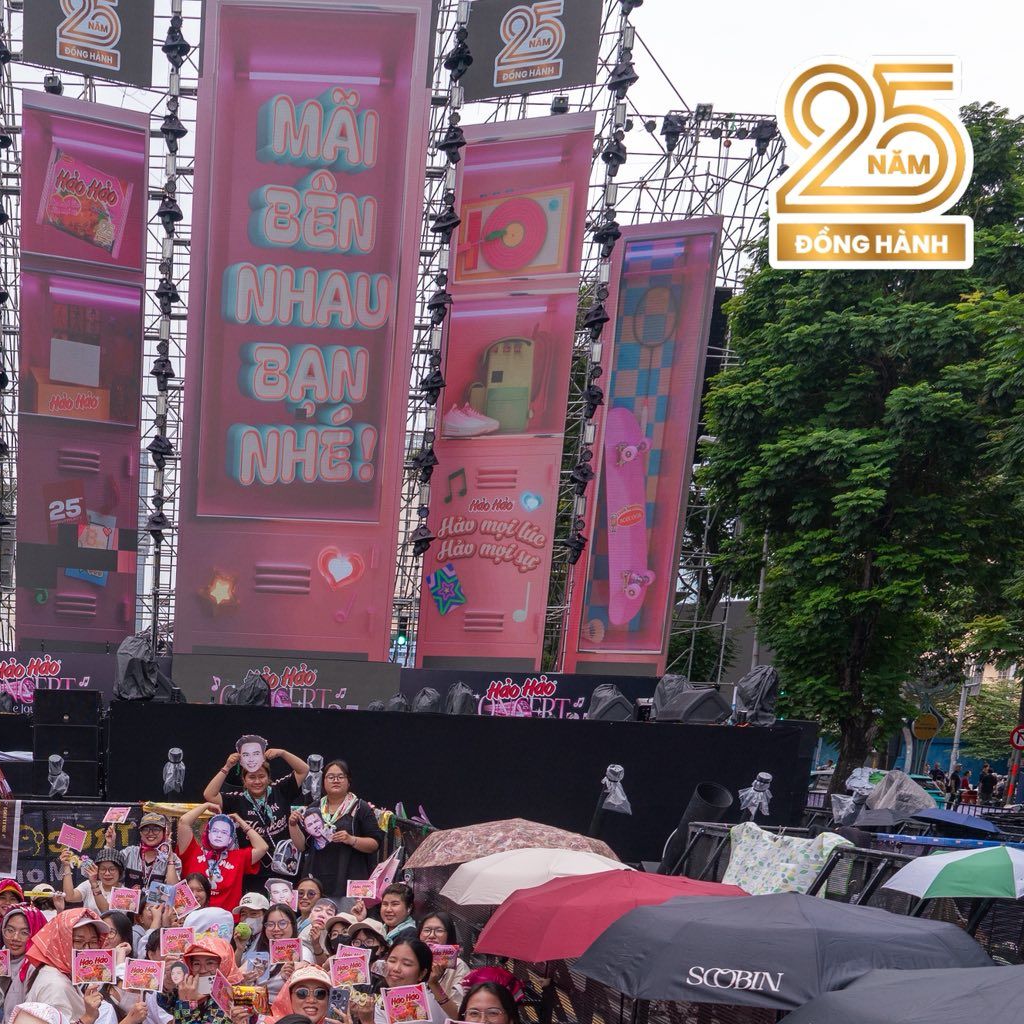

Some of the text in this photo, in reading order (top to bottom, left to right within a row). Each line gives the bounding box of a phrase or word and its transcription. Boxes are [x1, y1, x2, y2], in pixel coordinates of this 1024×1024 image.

[88, 21, 108, 33] NĂM
[497, 1, 564, 67] 25
[89, 50, 113, 64] HÀNH
[268, 87, 380, 170] MÃI
[56, 168, 118, 206] Hảo Hảo
[263, 170, 378, 252] BÊN
[233, 264, 392, 329] NHAU
[252, 345, 370, 419] BẠN
[238, 404, 378, 485] NHÉ!
[48, 497, 82, 521] 25
[437, 516, 546, 548] Hảo mọi lúc
[437, 540, 541, 573] Hảo mọi sự
[26, 654, 60, 678] Hảo
[280, 663, 317, 687] Hảo
[486, 675, 556, 700] Hảo Hảo
